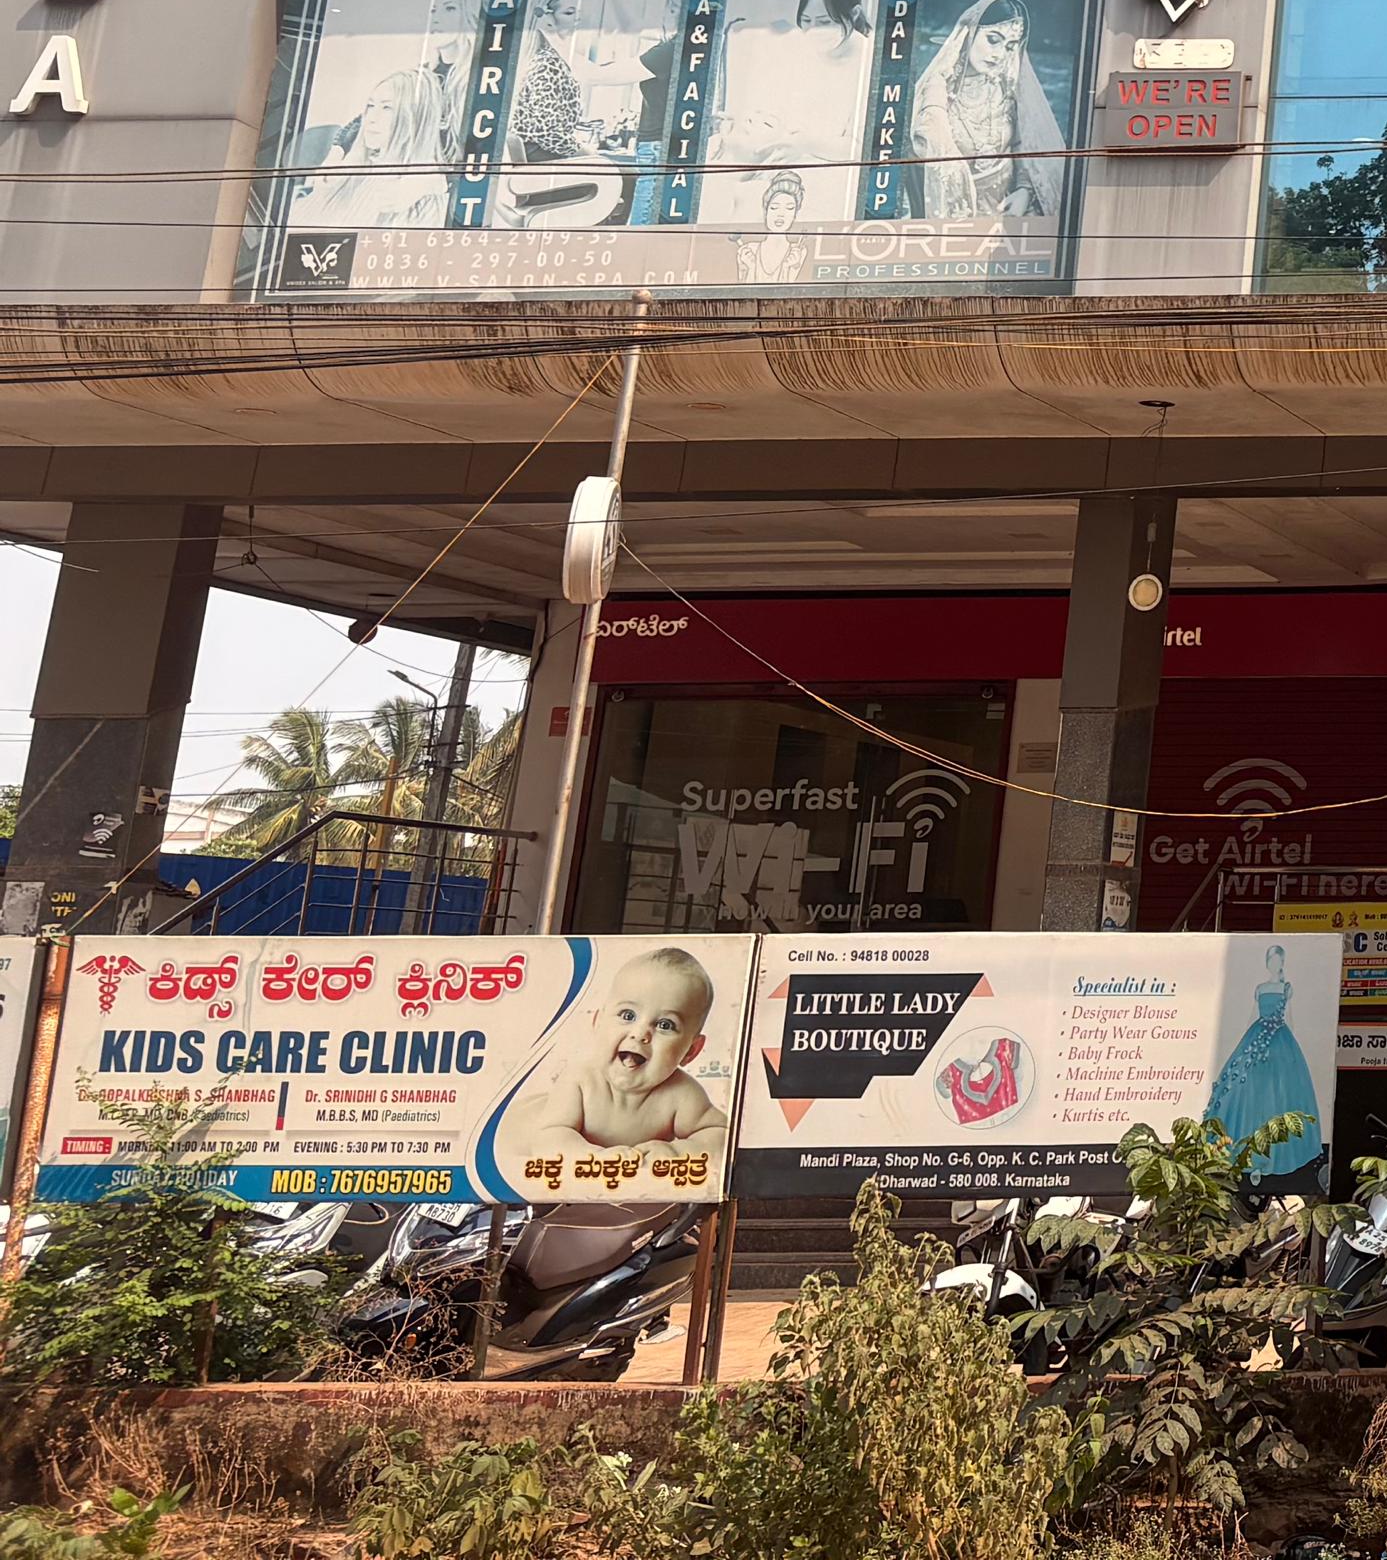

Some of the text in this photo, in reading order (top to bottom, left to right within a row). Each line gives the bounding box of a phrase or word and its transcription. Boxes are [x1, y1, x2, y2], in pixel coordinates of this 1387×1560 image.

[1118, 79, 1232, 105] WE'RE
[1127, 114, 1217, 139] OPEN
[817, 262, 1046, 278] PROFESSIONNEL
[680, 779, 860, 811] Superfast
[1149, 834, 1312, 865] Get Airtel
[869, 901, 923, 919] area
[788, 950, 929, 961] Cell No. 94818 00028
[148, 953, 525, 1019] ಕಿಡ್ಸ್ ಕೇರ್ ಕ್ಲಿನಿಕ್
[1073, 976, 1165, 996] Specialist in
[793, 993, 961, 1015] LITTLE LADY
[1072, 1005, 1177, 1023] Designer Blouse
[790, 1029, 927, 1055] BOUTIQUE
[1069, 1026, 1197, 1043] Party Wear Gowns
[100, 1030, 486, 1074] KIDS CARE CLINIC
[1068, 1046, 1143, 1064] Baby Frock
[1065, 1066, 1205, 1084] Machine Embroidery
[305, 1090, 457, 1103] Dr. SRINIDHI G SHANBHAG
[1064, 1087, 1182, 1105] Hand Embroidery
[361, 1110, 378, 1121] MD
[381, 1110, 440, 1123] (Paediatrics)
[1062, 1108, 1130, 1122] Kurtis etc.
[294, 1141, 450, 1153] EVENING 5:30 PM TO 7:30 PM
[574, 1153, 640, 1189] ಮಕ್ಕಳ
[800, 1152, 1070, 1188] Mandi Plaza, Shop Karnataka
[271, 1169, 452, 1194] MOB 7676957965
